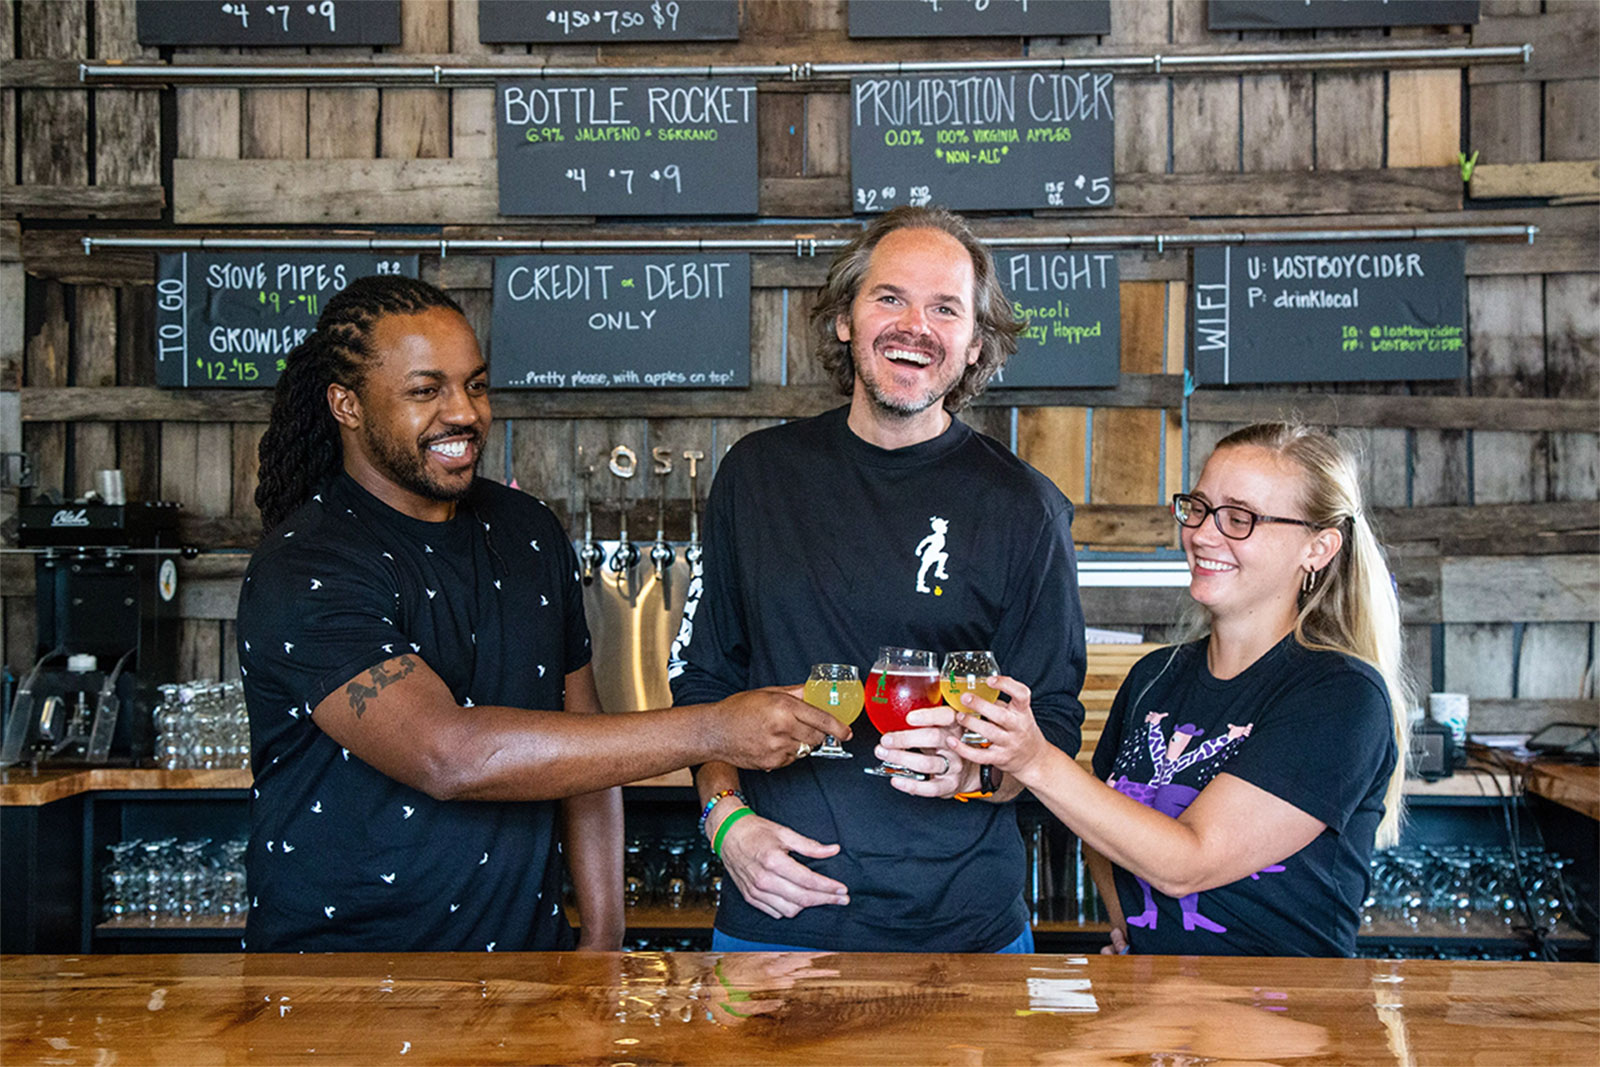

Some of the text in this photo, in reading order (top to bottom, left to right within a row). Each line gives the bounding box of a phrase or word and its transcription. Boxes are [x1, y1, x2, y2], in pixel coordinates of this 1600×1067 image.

[650, 0, 680, 31] $9
[504, 85, 758, 125] BOTTLE ROCKET
[855, 72, 1115, 126] PROHIBITION CIDER
[525, 127, 565, 142] 6.9%
[657, 127, 719, 142] SERRANO
[884, 127, 1072, 147] 0.0% 100% VIRGINIA APPLES
[206, 262, 347, 292] STOVE PIPES
[1010, 253, 1114, 292] FLIGHT
[1247, 253, 1425, 280] U: LOSTBOYCIDER
[507, 264, 614, 301] CREDIT
[645, 262, 730, 300] DEBIT
[1013, 300, 1070, 320] Spicoli
[1247, 287, 1267, 308] P:
[157, 278, 184, 361] TO GO
[588, 308, 657, 330] ONLY
[1197, 284, 1227, 351] WIFI
[209, 325, 318, 354] GROWLER
[1016, 321, 1101, 345] azy Hopped
[571, 370, 610, 387] please,
[613, 369, 640, 383] with
[644, 370, 686, 386] apples
[689, 373, 705, 382] on
[709, 369, 735, 385] top!
